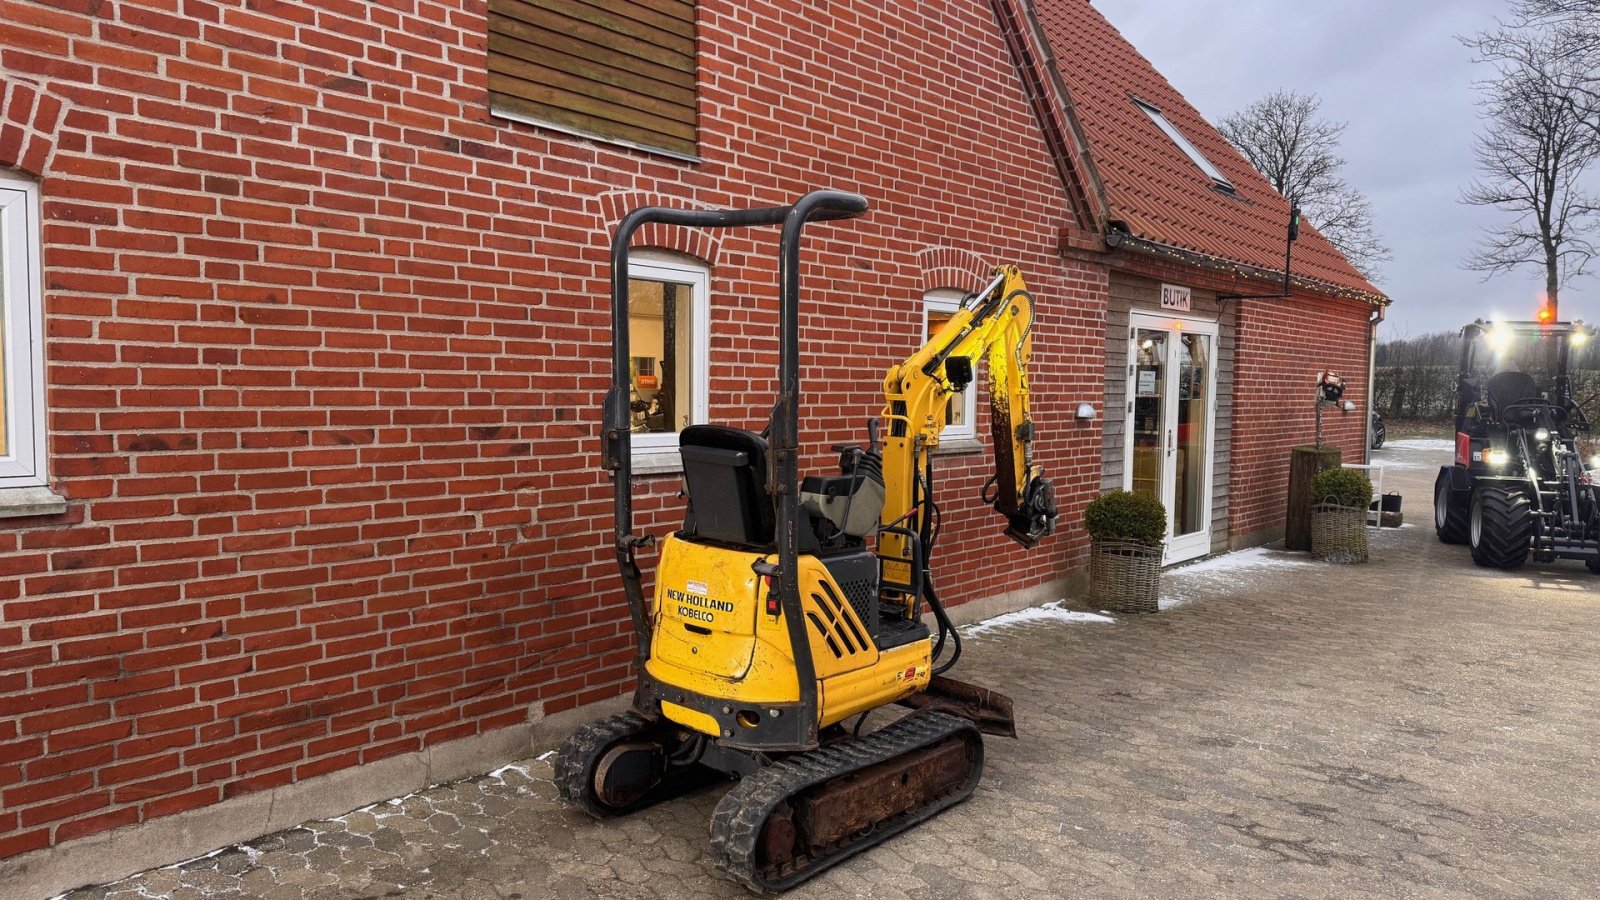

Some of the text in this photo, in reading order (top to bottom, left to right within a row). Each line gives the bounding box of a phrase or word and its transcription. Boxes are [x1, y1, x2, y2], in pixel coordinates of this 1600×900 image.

[1163, 288, 1188, 307] BUTIK
[667, 588, 734, 612] NEW HOLLAND
[678, 605, 714, 622] KOBELCO
